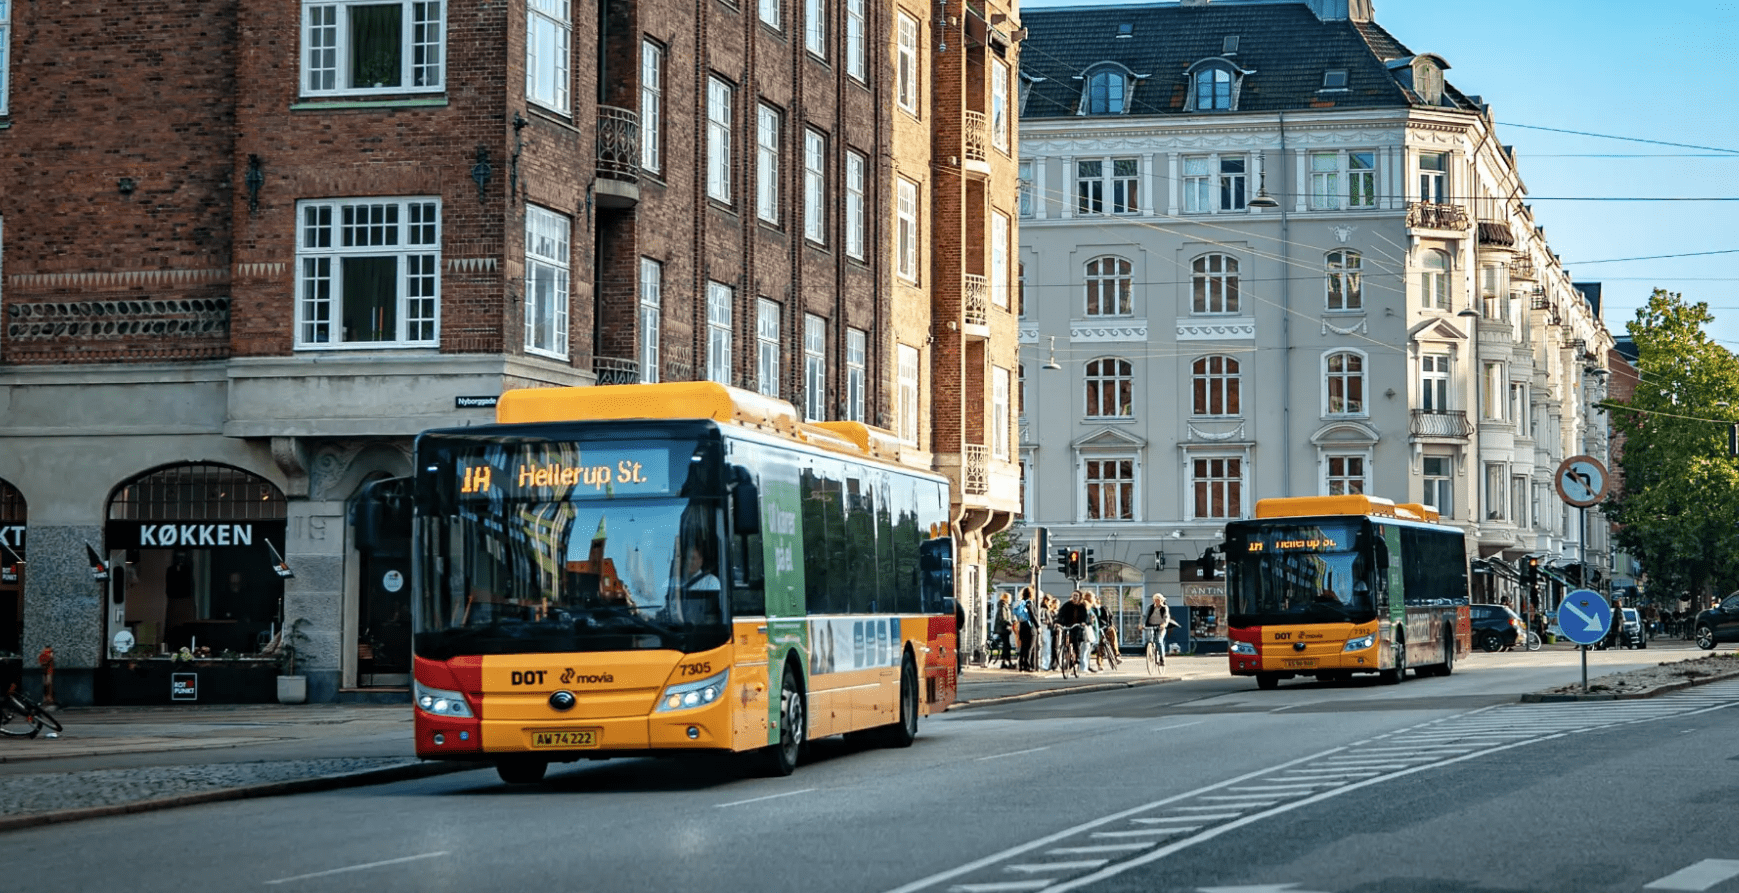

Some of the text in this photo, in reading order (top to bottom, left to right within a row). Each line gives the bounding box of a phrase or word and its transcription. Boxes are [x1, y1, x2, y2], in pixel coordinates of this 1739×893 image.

[458, 398, 497, 407] Nyborggade
[519, 463, 612, 491] Hellerup
[617, 460, 647, 484] St.
[140, 524, 252, 546] KØKKEN
[1275, 632, 1291, 640] DOT
[679, 662, 711, 676] 7305
[511, 670, 547, 686] DOT
[577, 672, 614, 684] movia
[554, 734, 569, 744] 74
[570, 733, 592, 744] 222
